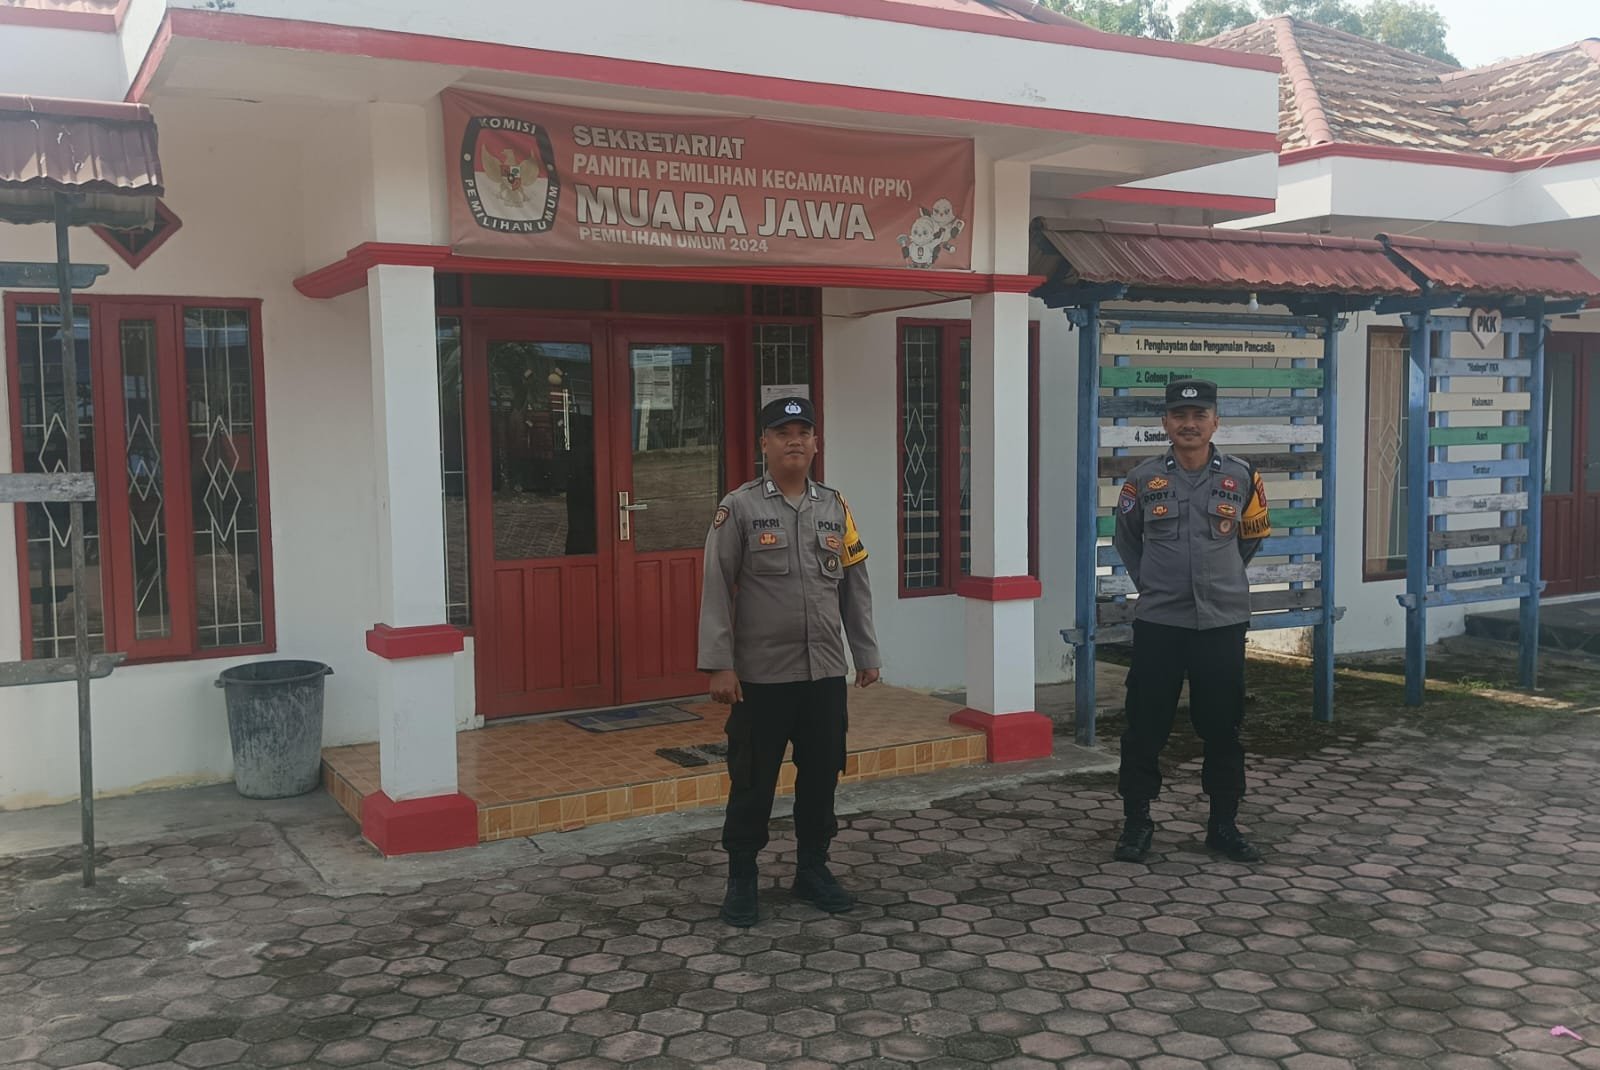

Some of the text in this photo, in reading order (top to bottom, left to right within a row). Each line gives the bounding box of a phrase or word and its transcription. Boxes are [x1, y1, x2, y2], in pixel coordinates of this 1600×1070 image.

[479, 118, 536, 134] KOMISI
[572, 126, 744, 160] SEKRETARIAT
[572, 153, 912, 200] PANITIA PEMILIHAN KECAMATAN (PPK)
[464, 179, 559, 231] PEMILIHAN UMUM
[575, 184, 875, 241] MUARA JAWA
[579, 227, 768, 253] PEMILIHAN UMUM 2024
[1477, 316, 1497, 332] PKK
[1136, 340, 1142, 351] 1.
[1144, 339, 1188, 354] Penghayatan
[1189, 341, 1202, 351] dan
[1244, 341, 1275, 353] Pancasila
[1144, 371, 1168, 385] Gotong
[1135, 431, 1142, 442] 4.
[1144, 491, 1169, 504] DODY
[1212, 489, 1242, 502] POLRI
[752, 519, 780, 530] FIKRI
